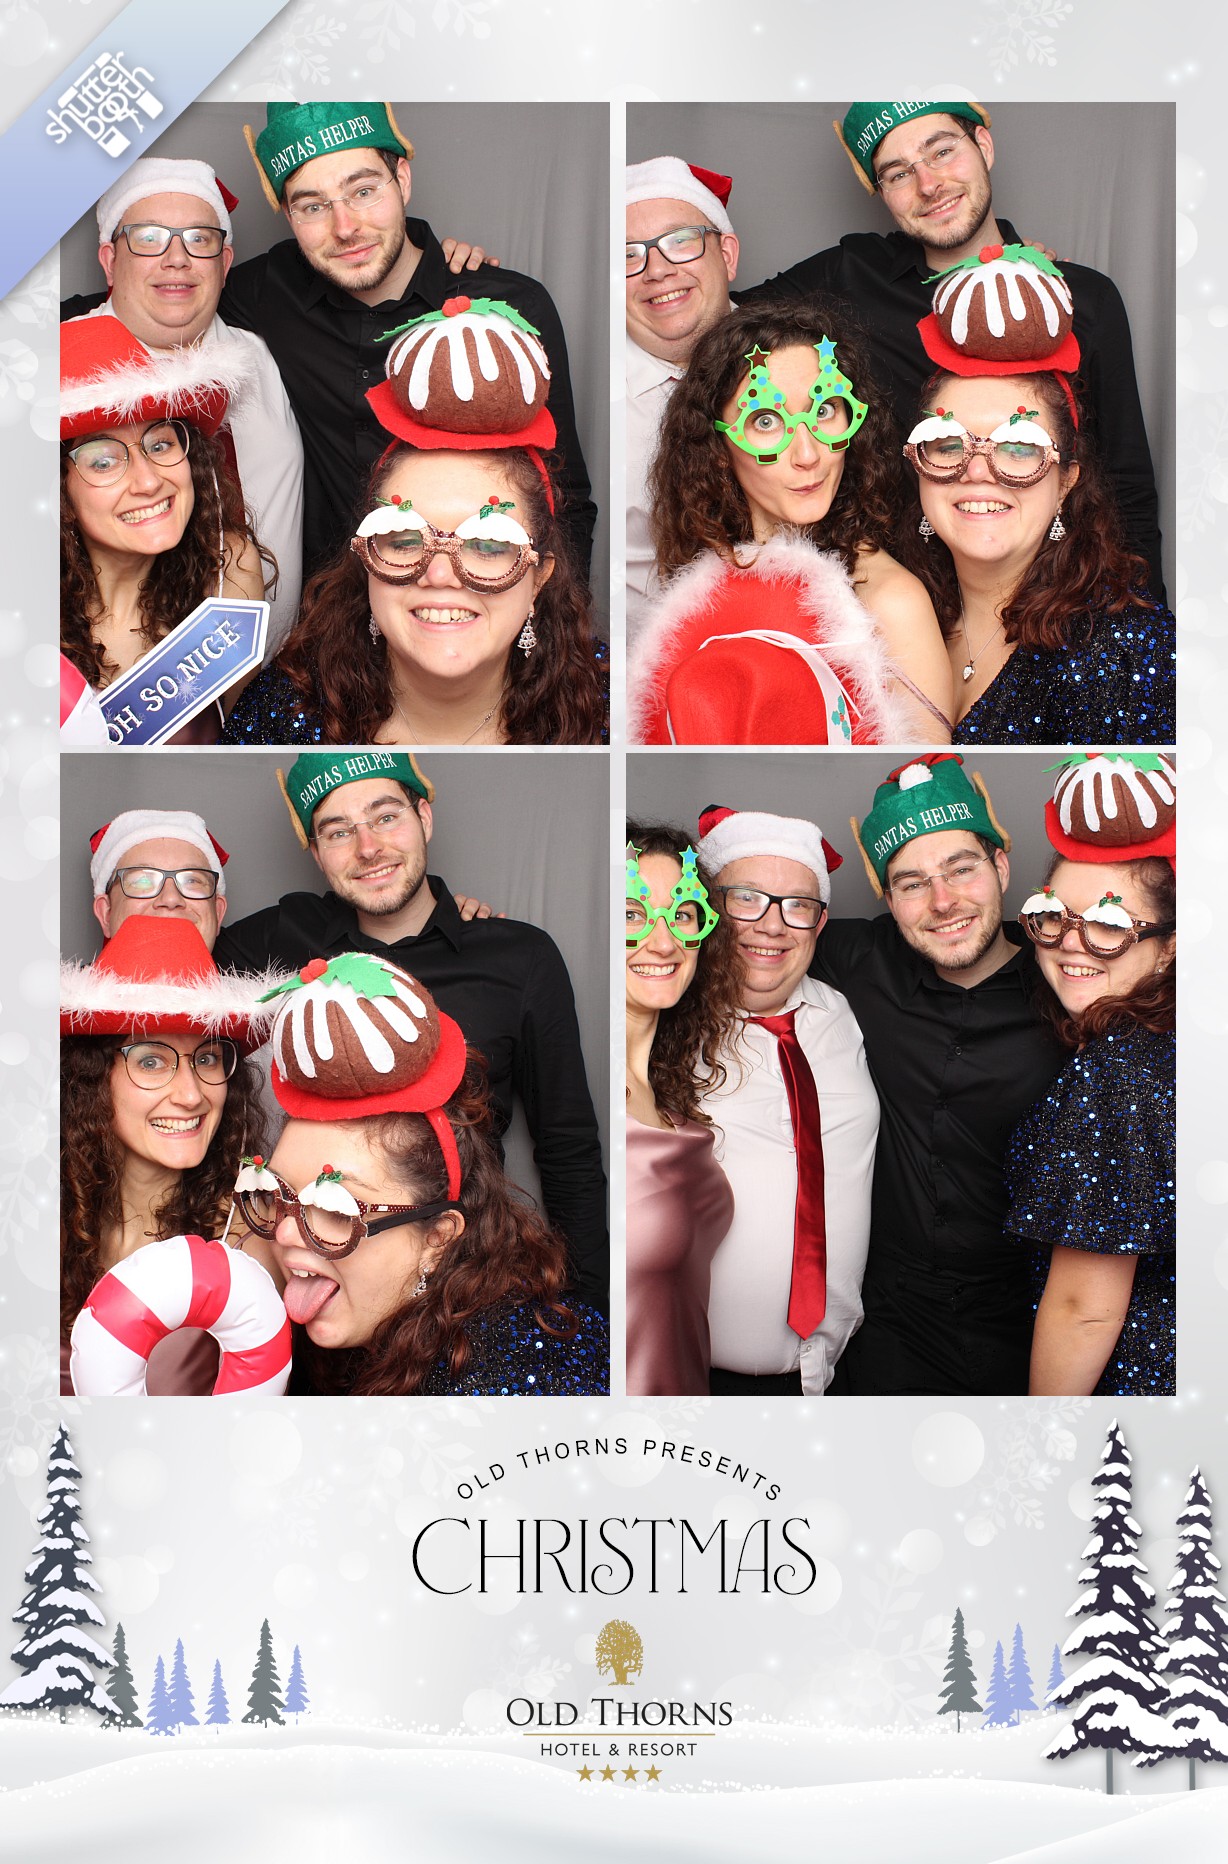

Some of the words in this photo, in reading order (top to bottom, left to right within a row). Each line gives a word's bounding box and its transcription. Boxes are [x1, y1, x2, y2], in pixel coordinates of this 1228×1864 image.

[270, 135, 317, 177] SANTAS
[318, 115, 375, 149] HELPER
[856, 109, 894, 157] SANTAS
[139, 675, 179, 712] SO
[176, 619, 242, 682] NICE
[300, 765, 343, 809] SANTAS
[343, 753, 398, 778] HELPER
[874, 816, 918, 860] SANTAS
[919, 802, 974, 830] HELPER
